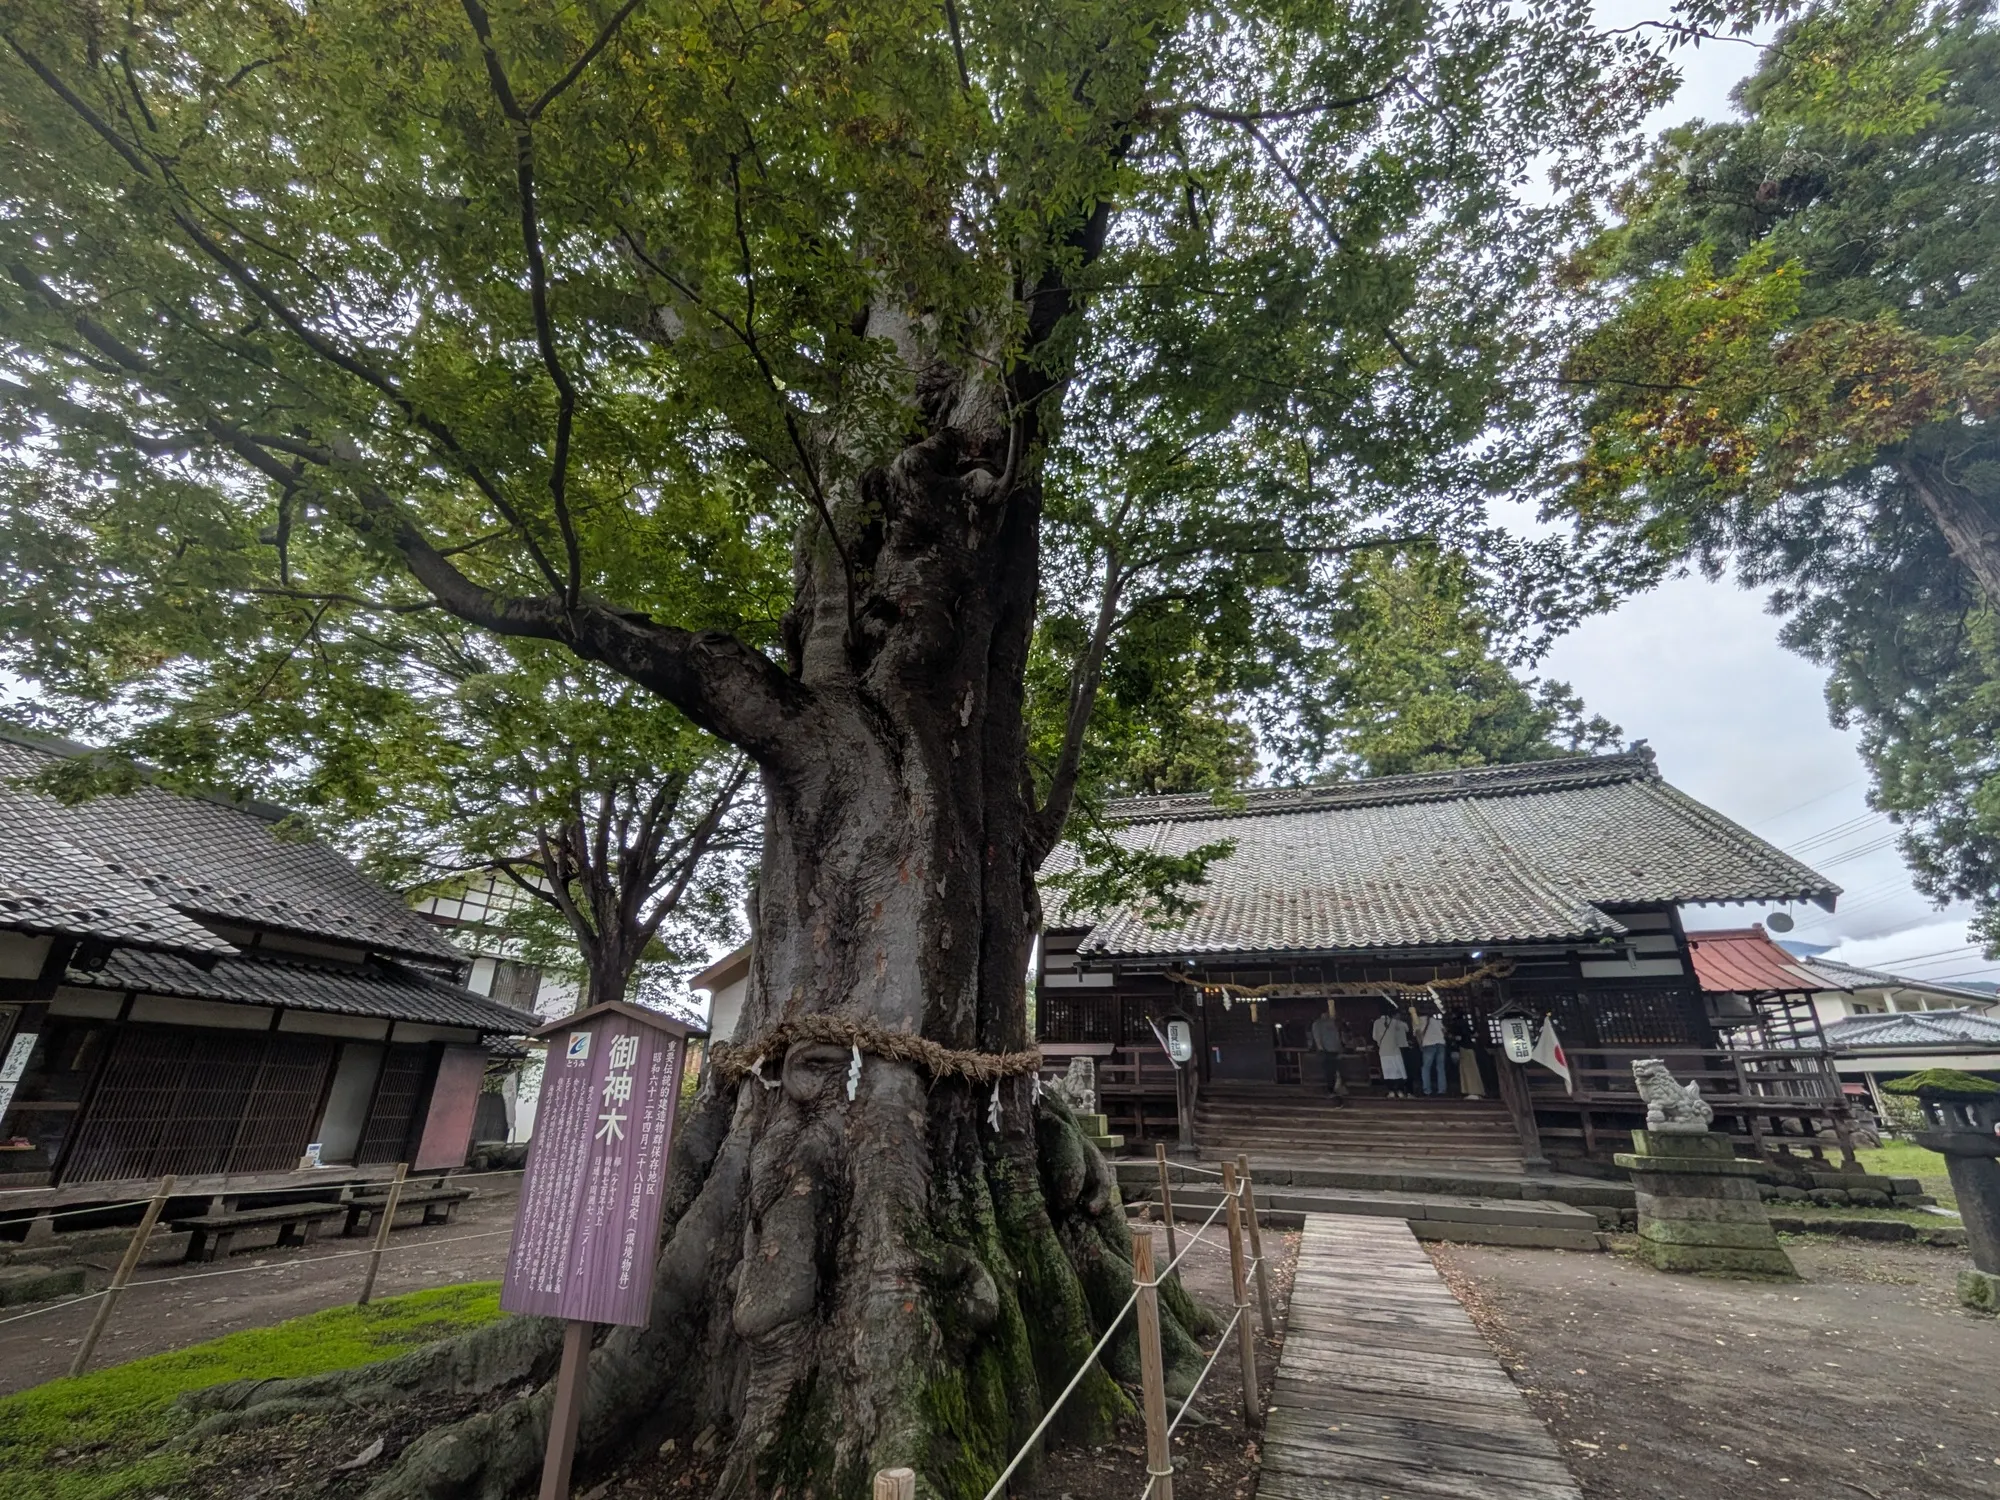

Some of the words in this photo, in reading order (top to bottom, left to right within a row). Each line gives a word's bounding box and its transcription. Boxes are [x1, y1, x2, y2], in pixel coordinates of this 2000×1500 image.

[566, 1059, 586, 1068] とうみ
[595, 1035, 639, 1146] 御神木
[646, 1040, 676, 1195] 重要伝統的建造物群保存地区
[595, 1156, 612, 1226] 樹齢七百年以上
